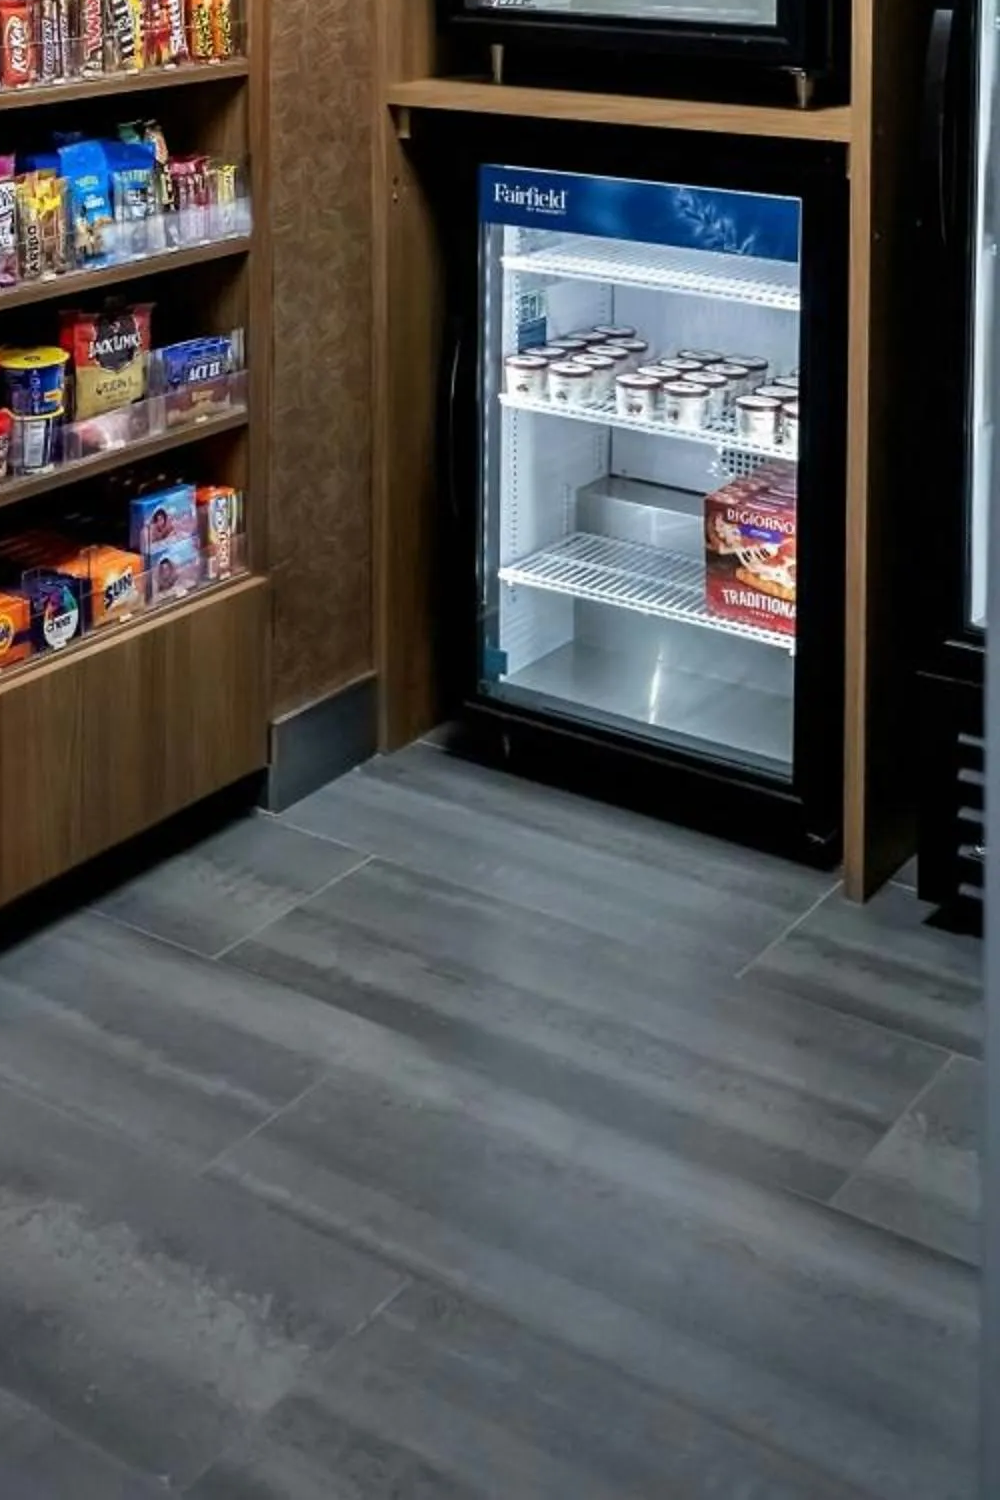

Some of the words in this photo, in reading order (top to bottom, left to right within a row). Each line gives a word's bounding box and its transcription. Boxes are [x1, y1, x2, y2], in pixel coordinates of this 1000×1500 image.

[494, 182, 566, 210] Fairfield
[26, 224, 40, 273] ARIBO
[104, 571, 134, 611] SUN
[722, 588, 797, 618] TRADITIONA
